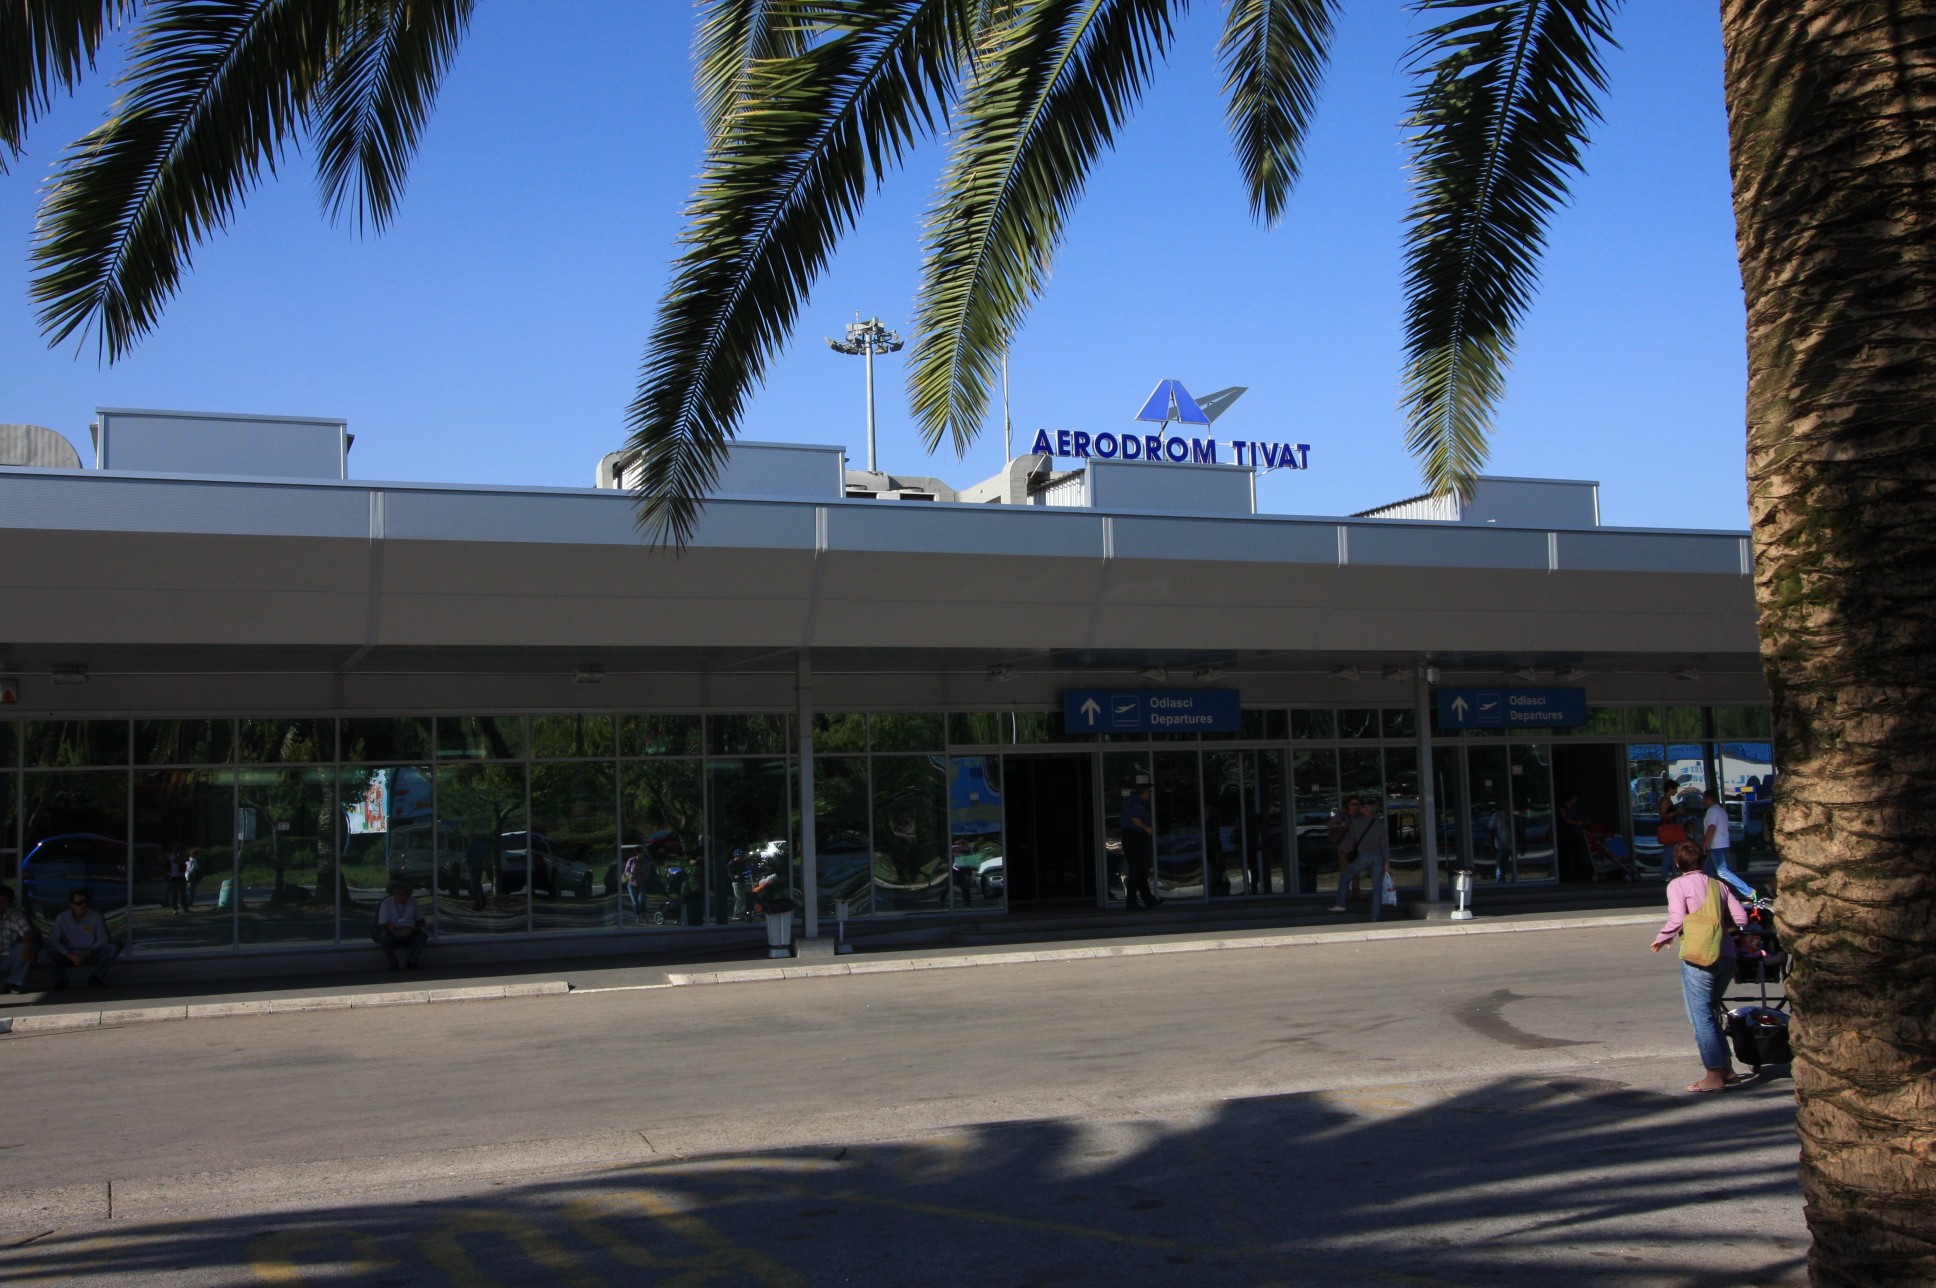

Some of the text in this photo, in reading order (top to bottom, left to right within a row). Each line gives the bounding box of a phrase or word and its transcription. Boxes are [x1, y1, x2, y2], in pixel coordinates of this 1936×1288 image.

[1031, 428, 1311, 470] AERODROM TIVAT
[1150, 697, 1193, 708] Odlasci
[1509, 695, 1546, 706] Odlasci
[1151, 713, 1213, 727] Departures
[1510, 710, 1564, 722] Departures
